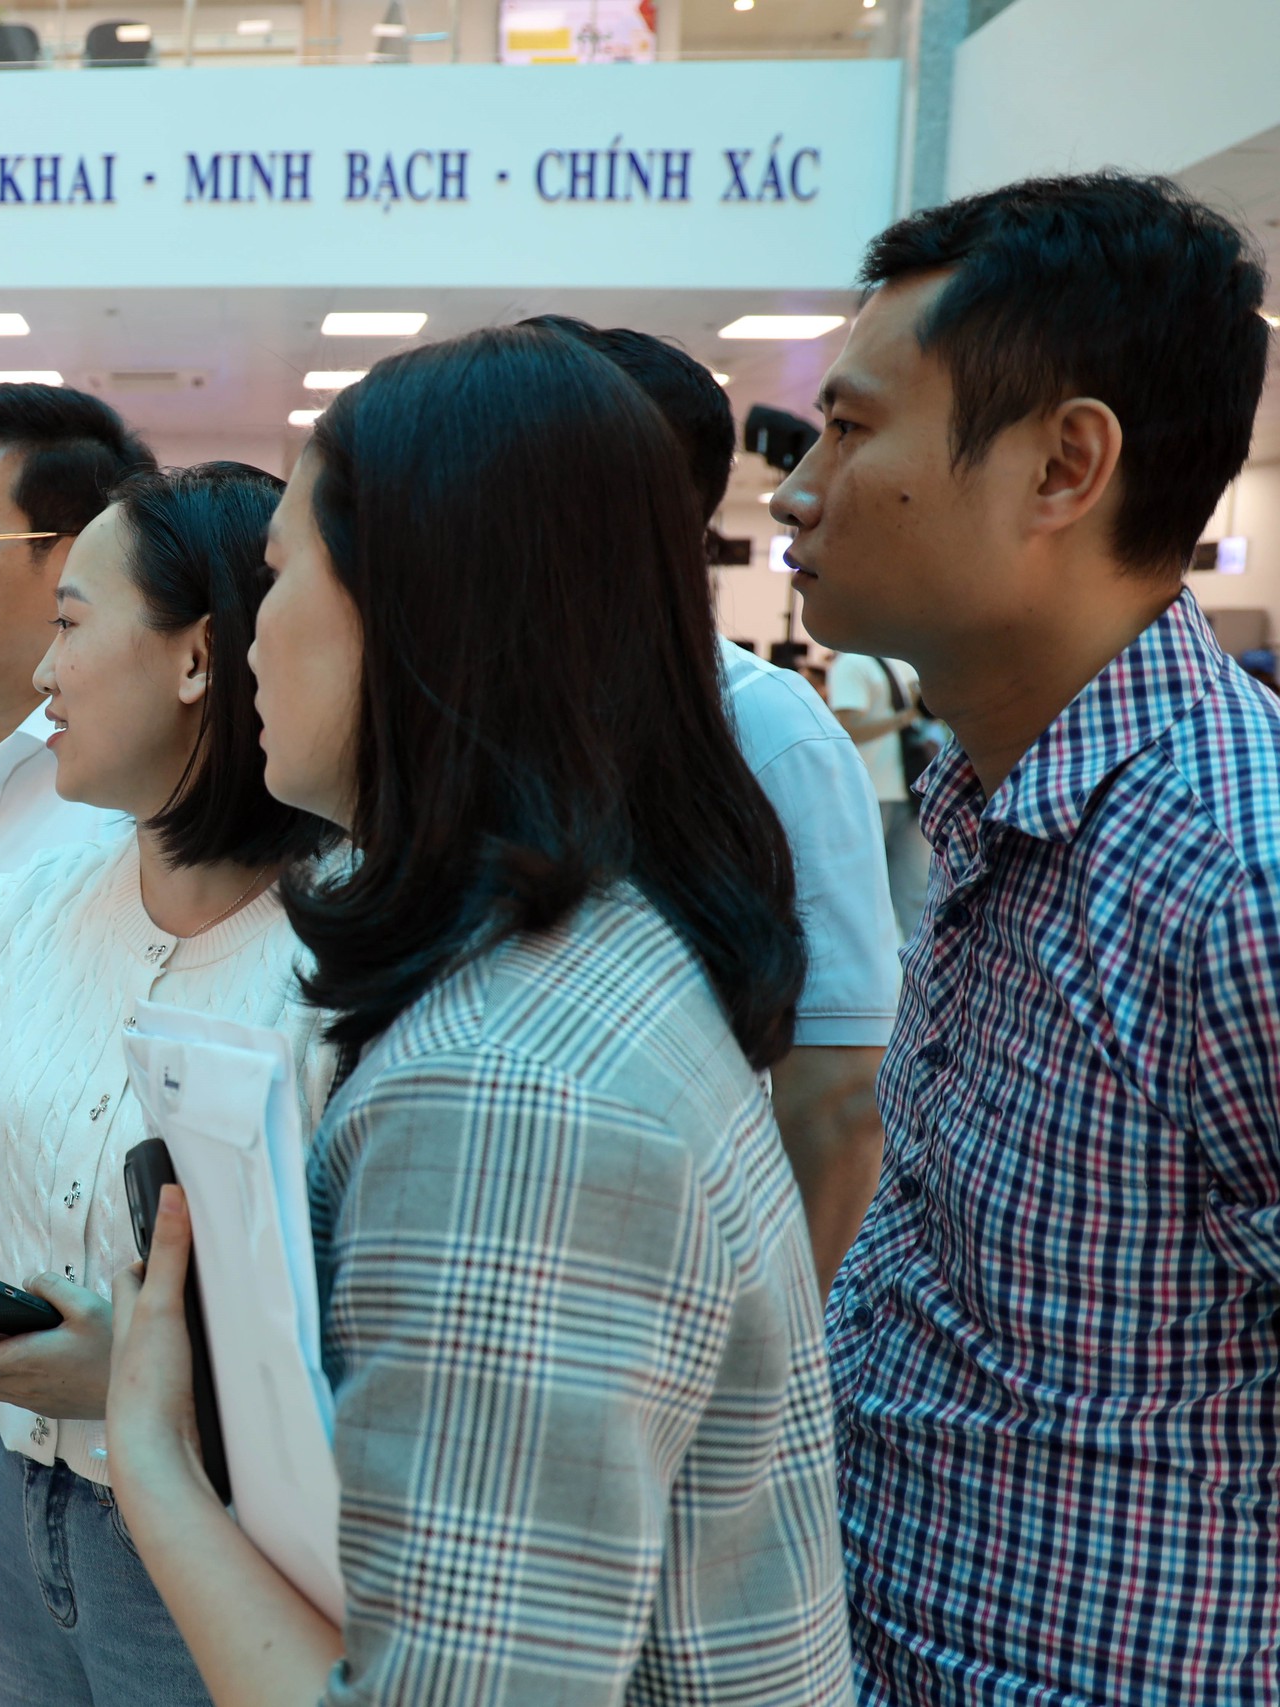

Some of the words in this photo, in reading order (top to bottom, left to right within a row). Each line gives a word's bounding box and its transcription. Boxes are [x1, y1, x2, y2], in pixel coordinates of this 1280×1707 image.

[185, 151, 313, 204] MINH
[344, 150, 470, 213] BẠCH
[534, 134, 694, 203] CHÍNH
[721, 132, 821, 203] XÁC
